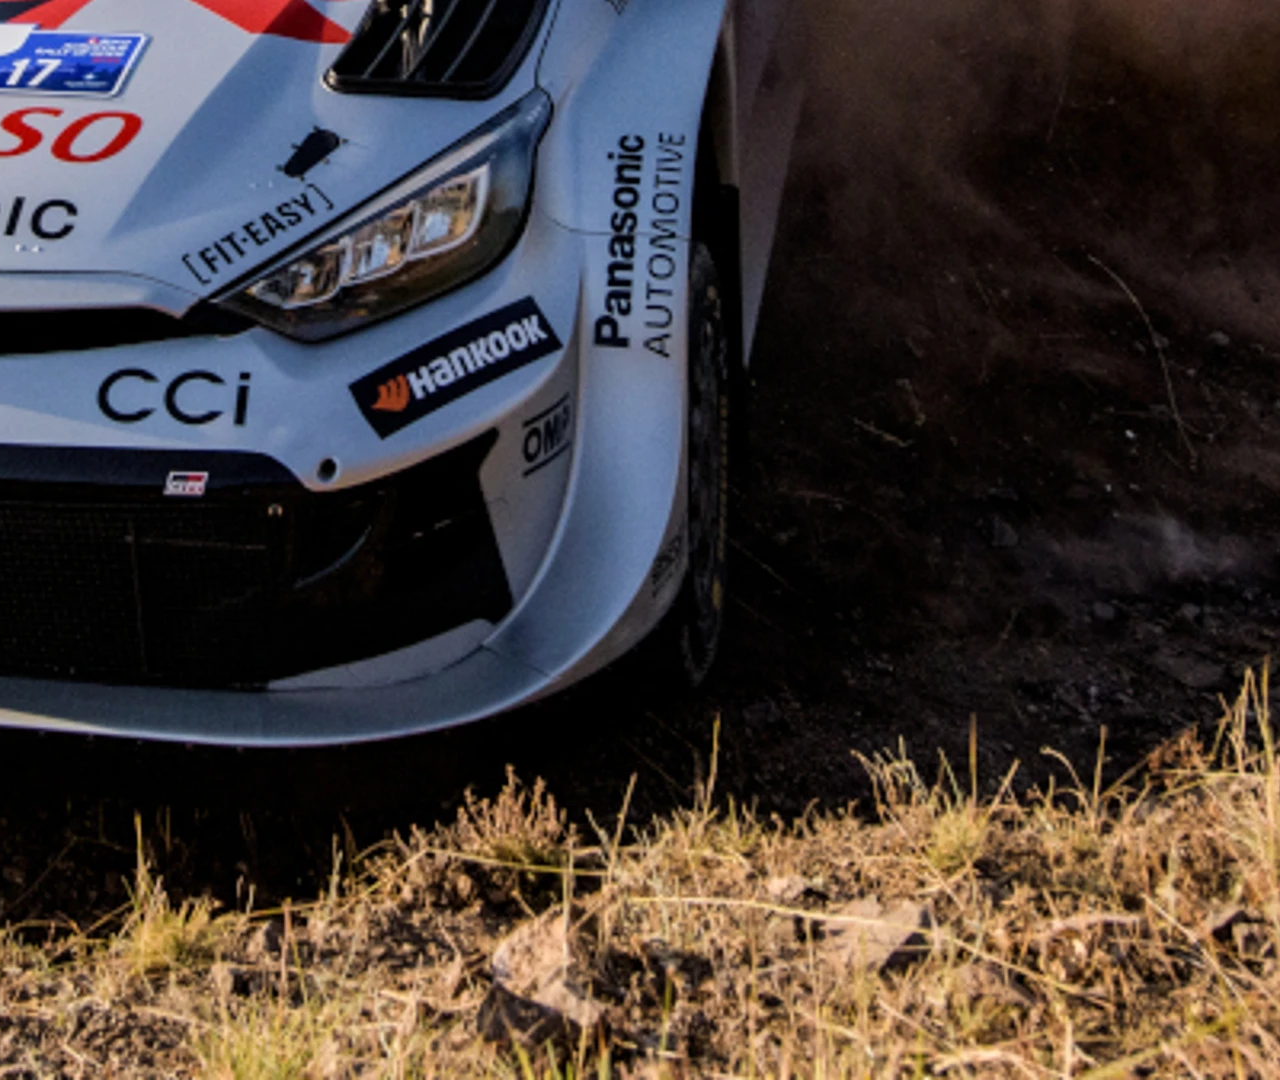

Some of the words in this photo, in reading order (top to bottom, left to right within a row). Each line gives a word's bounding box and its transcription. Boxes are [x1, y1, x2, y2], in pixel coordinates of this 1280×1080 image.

[6, 59, 62, 86] 17
[593, 134, 645, 349] Panasonic
[643, 132, 686, 358] AUTOMOTIVE
[97, 367, 251, 427] CCi
